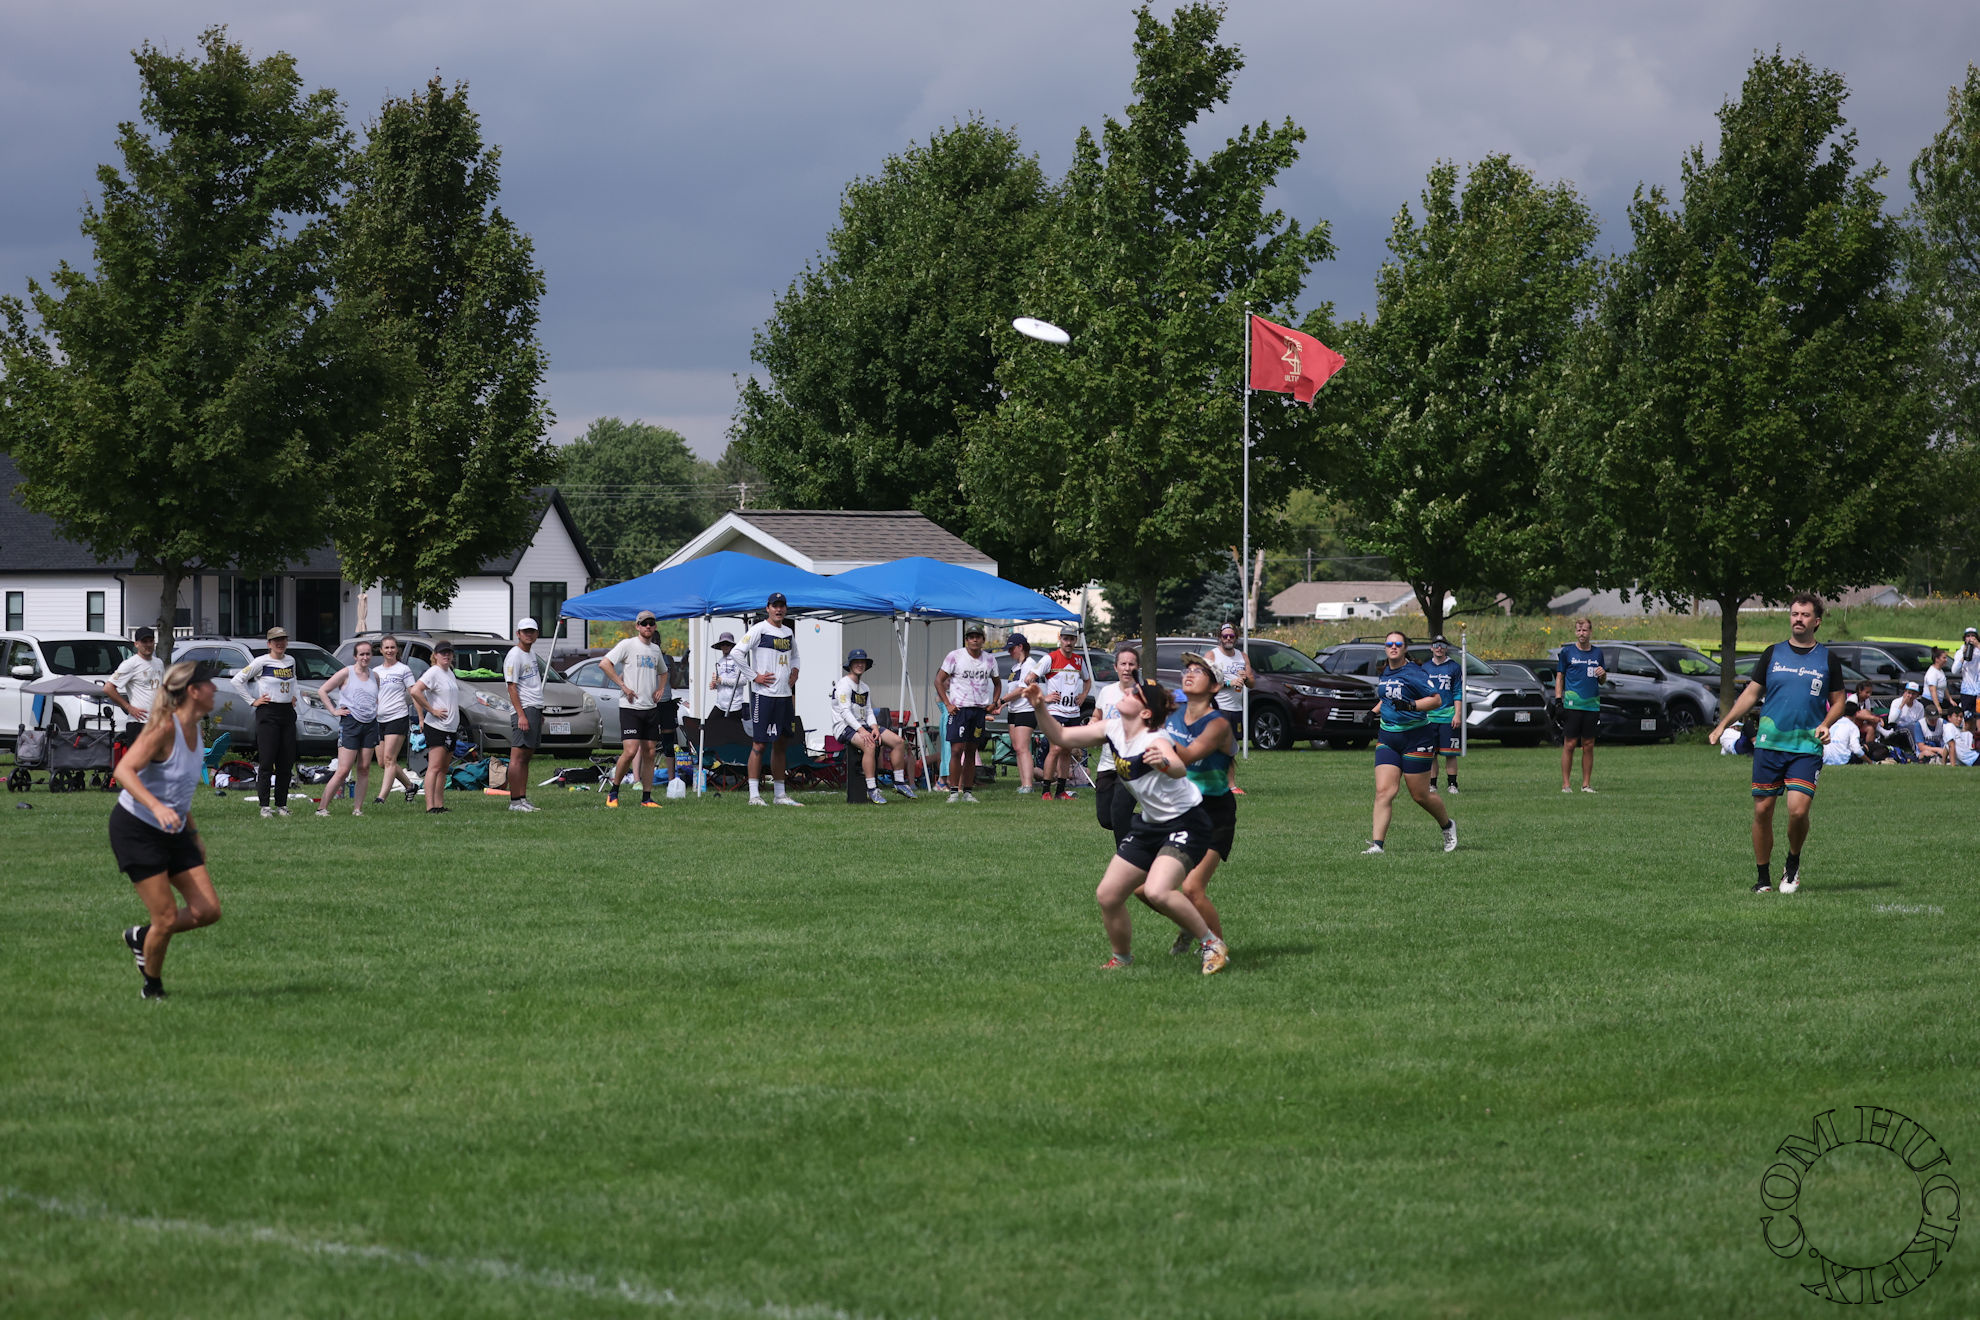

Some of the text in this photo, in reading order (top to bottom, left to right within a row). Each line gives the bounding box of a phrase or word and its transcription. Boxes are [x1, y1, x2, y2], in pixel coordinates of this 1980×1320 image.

[773, 638, 791, 650] NOISE
[1772, 665, 1824, 679] Midwest Goodbye
[280, 682, 290, 694] 33
[1438, 679, 1450, 690] 72
[1810, 678, 1823, 697] 9
[766, 723, 778, 736] 44
[1450, 738, 1460, 749] 72
[1169, 830, 1189, 845] 12
